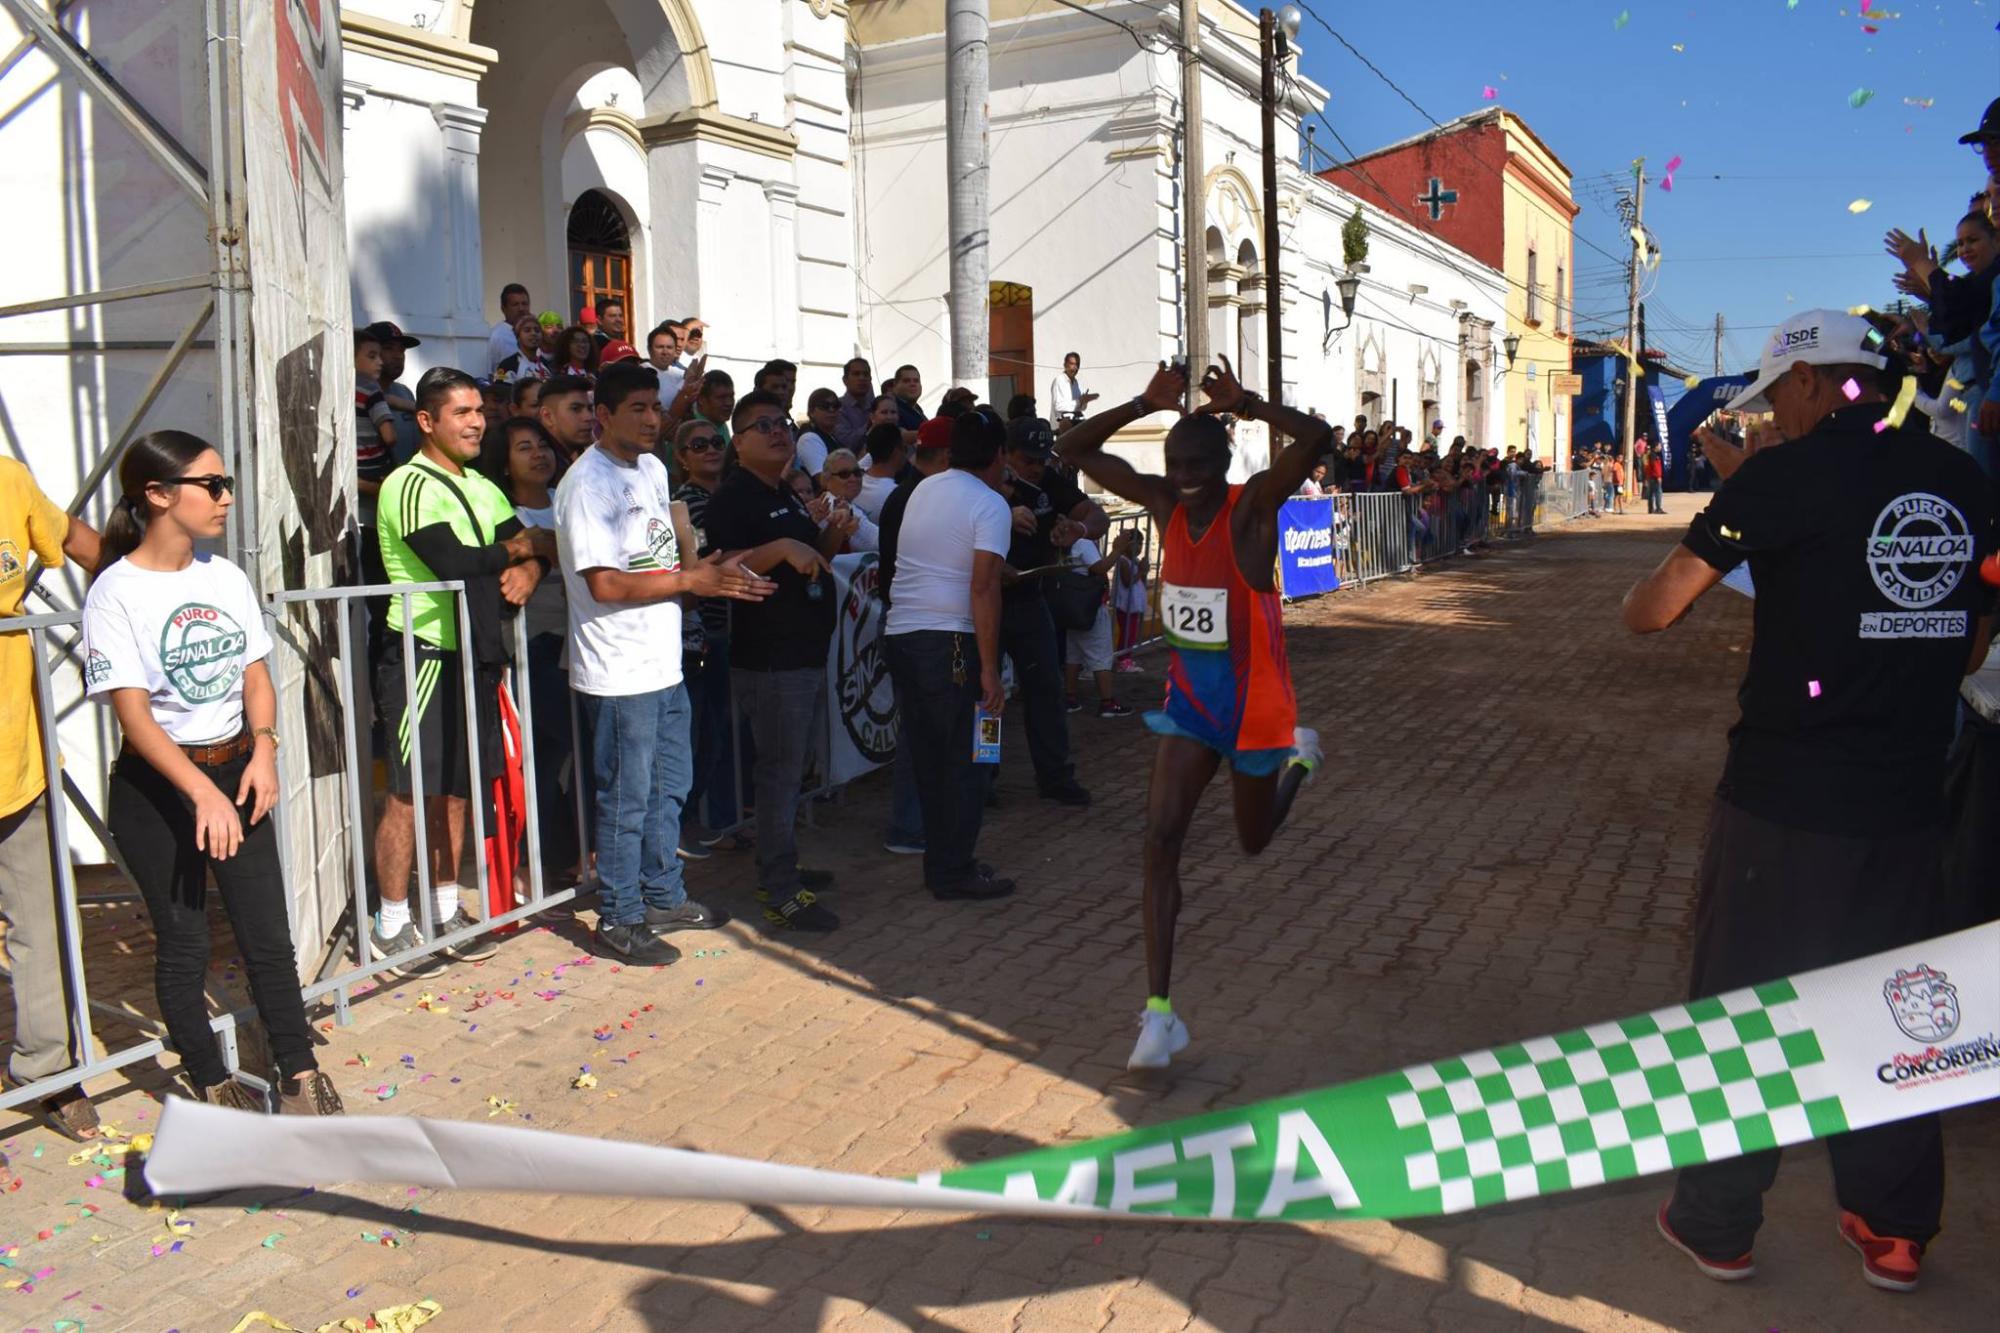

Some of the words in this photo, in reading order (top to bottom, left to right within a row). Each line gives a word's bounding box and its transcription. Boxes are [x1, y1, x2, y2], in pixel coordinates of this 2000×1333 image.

[1785, 327, 1819, 346] ISDE
[1893, 500, 1947, 519] PURO
[1870, 539, 1968, 558] SINALOA
[1880, 570, 1956, 601] CALIDAD
[172, 607, 219, 629] PURO
[1168, 604, 1214, 633] 128
[1862, 624, 1878, 632] EN
[1880, 617, 1965, 633] DEPORTES
[165, 632, 246, 671] SINALOA
[176, 664, 240, 698] CALIDAD
[1877, 1040, 2000, 1084] CONCORDEN
